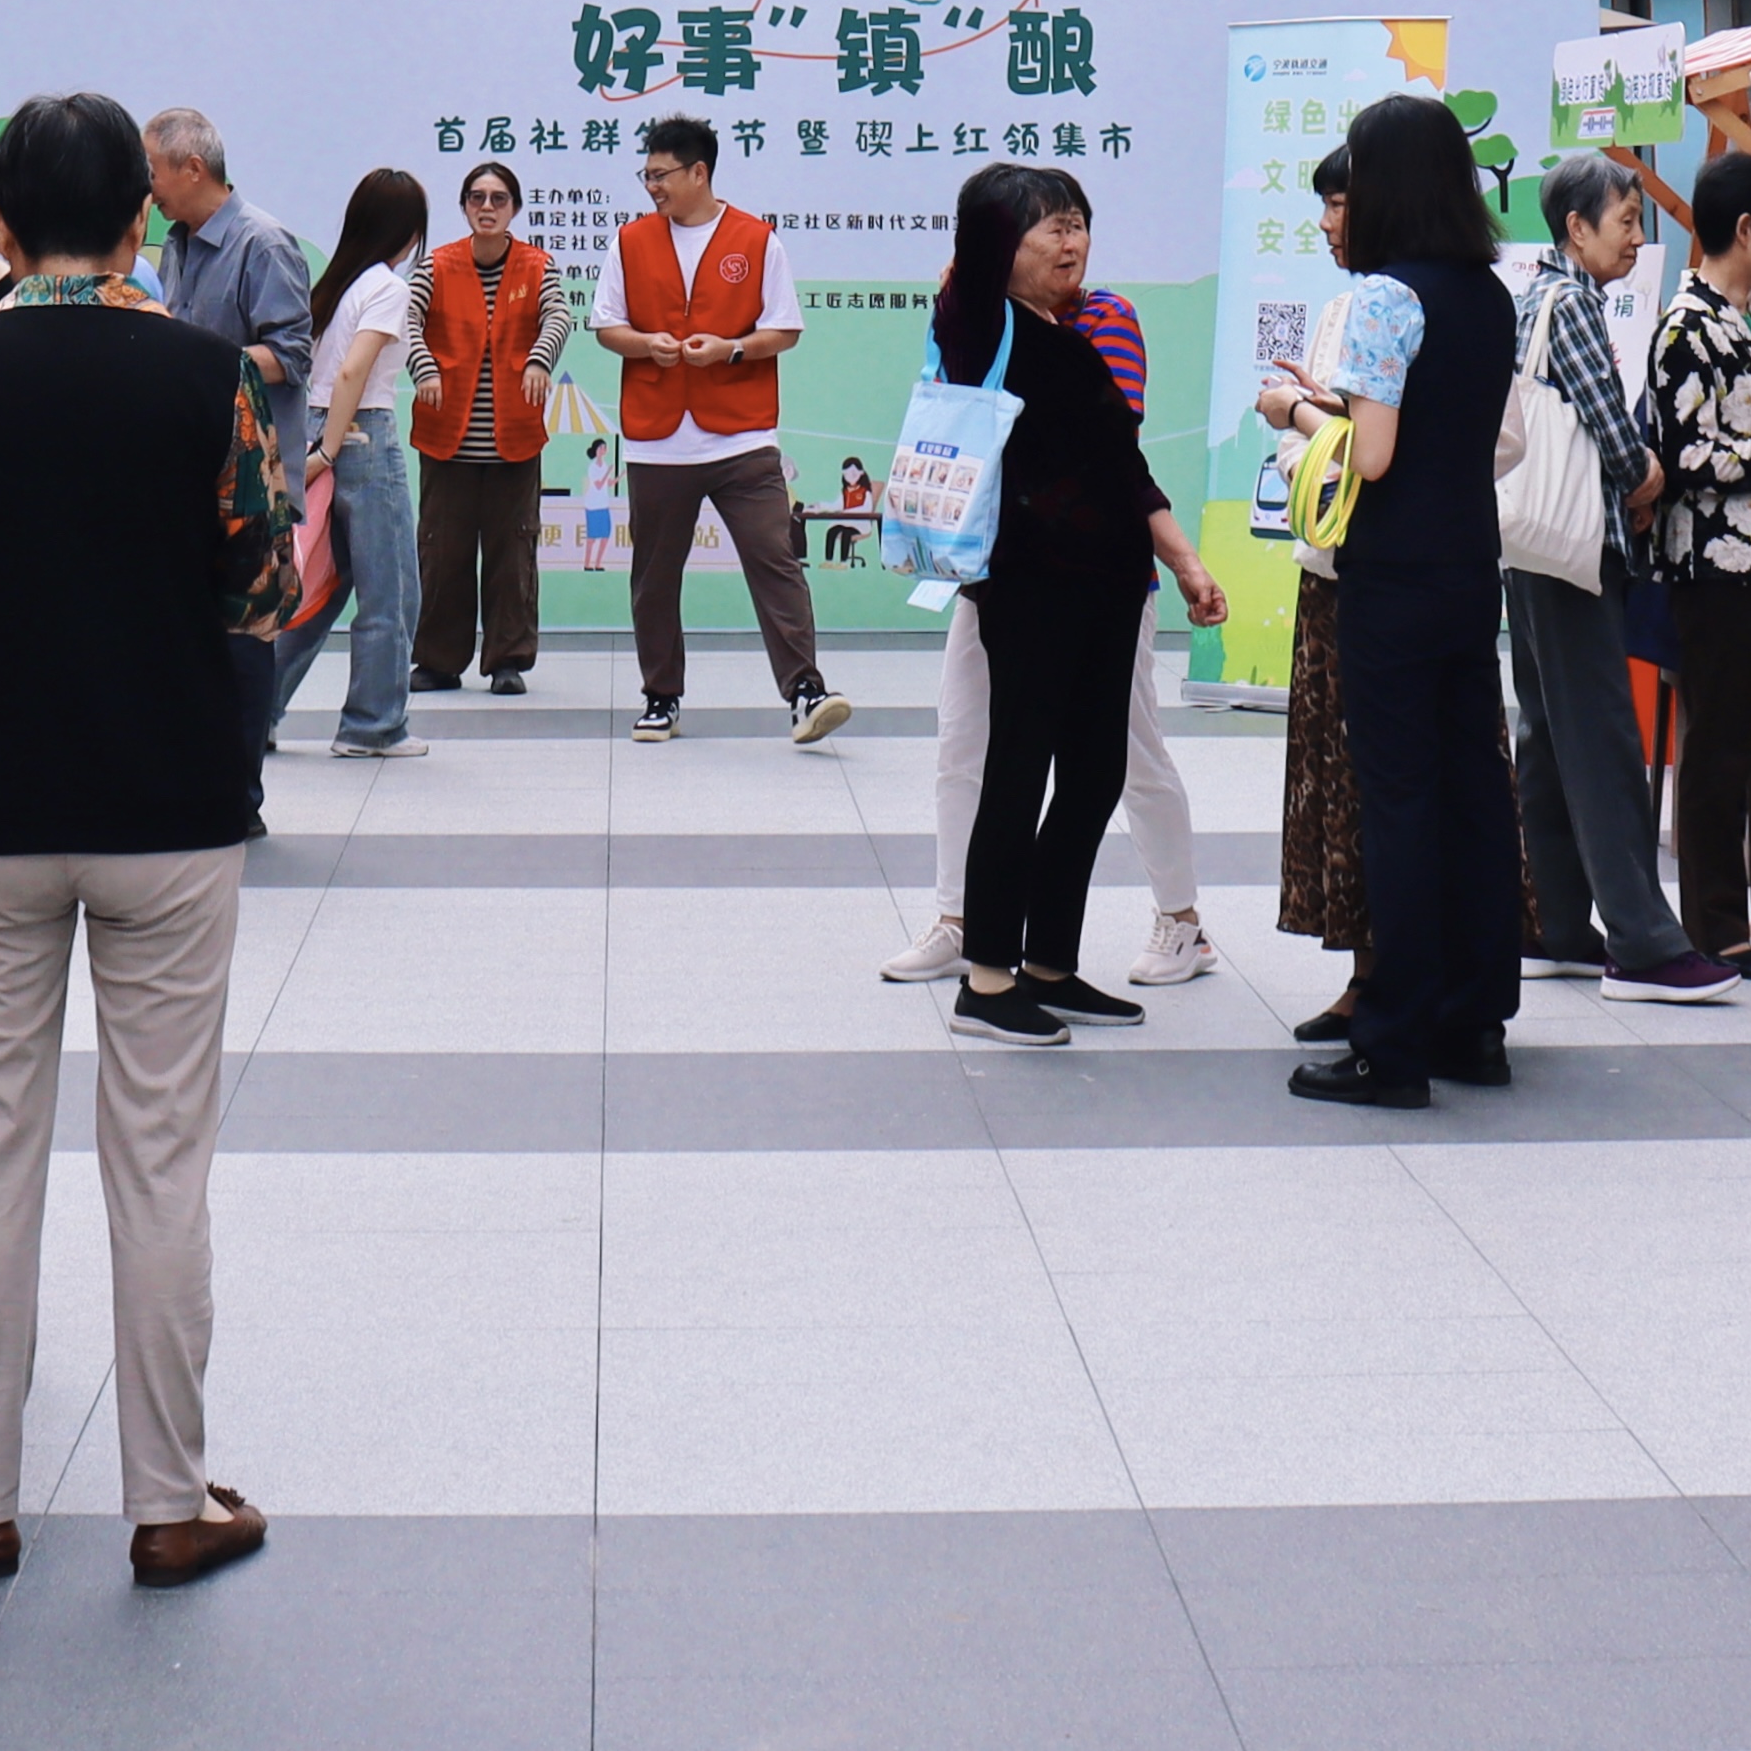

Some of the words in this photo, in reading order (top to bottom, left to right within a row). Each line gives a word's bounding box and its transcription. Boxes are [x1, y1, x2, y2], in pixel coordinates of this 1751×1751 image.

[1262, 99, 1363, 136] 绿色出
[1255, 217, 1320, 256] 安全
